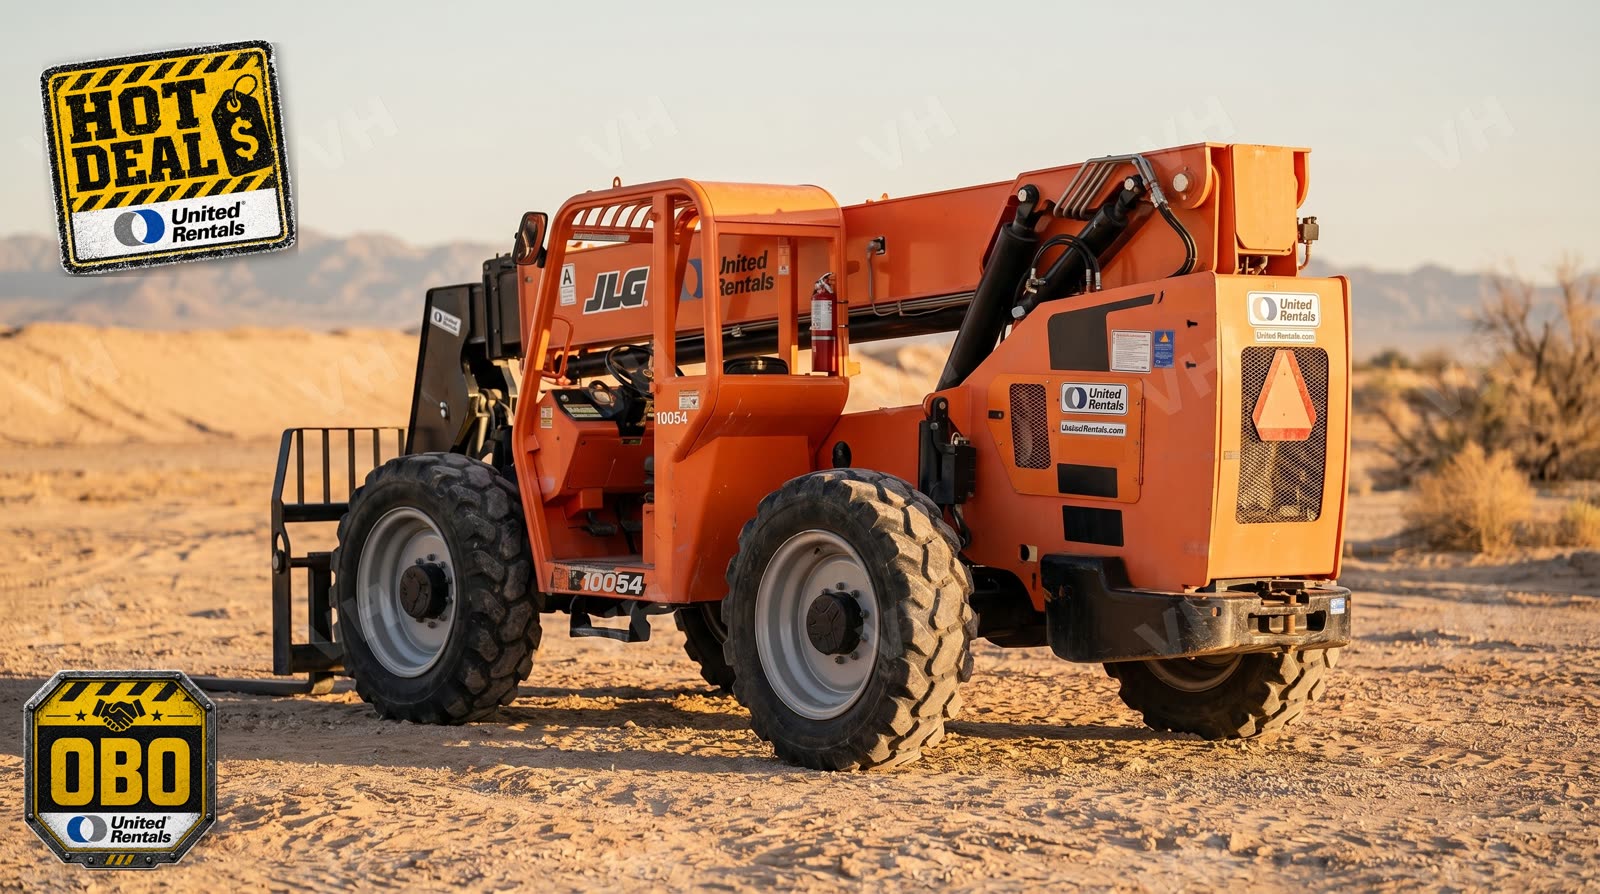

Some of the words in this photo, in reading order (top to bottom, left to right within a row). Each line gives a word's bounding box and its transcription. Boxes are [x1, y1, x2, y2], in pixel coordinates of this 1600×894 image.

[562, 268, 573, 286] A
[582, 266, 650, 315] JLG
[1280, 298, 1312, 310] United
[1280, 310, 1316, 322] Rentals
[1089, 387, 1122, 400] United
[1088, 398, 1125, 411] Rentals
[656, 411, 688, 425] 10054
[583, 572, 643, 595] 10054
